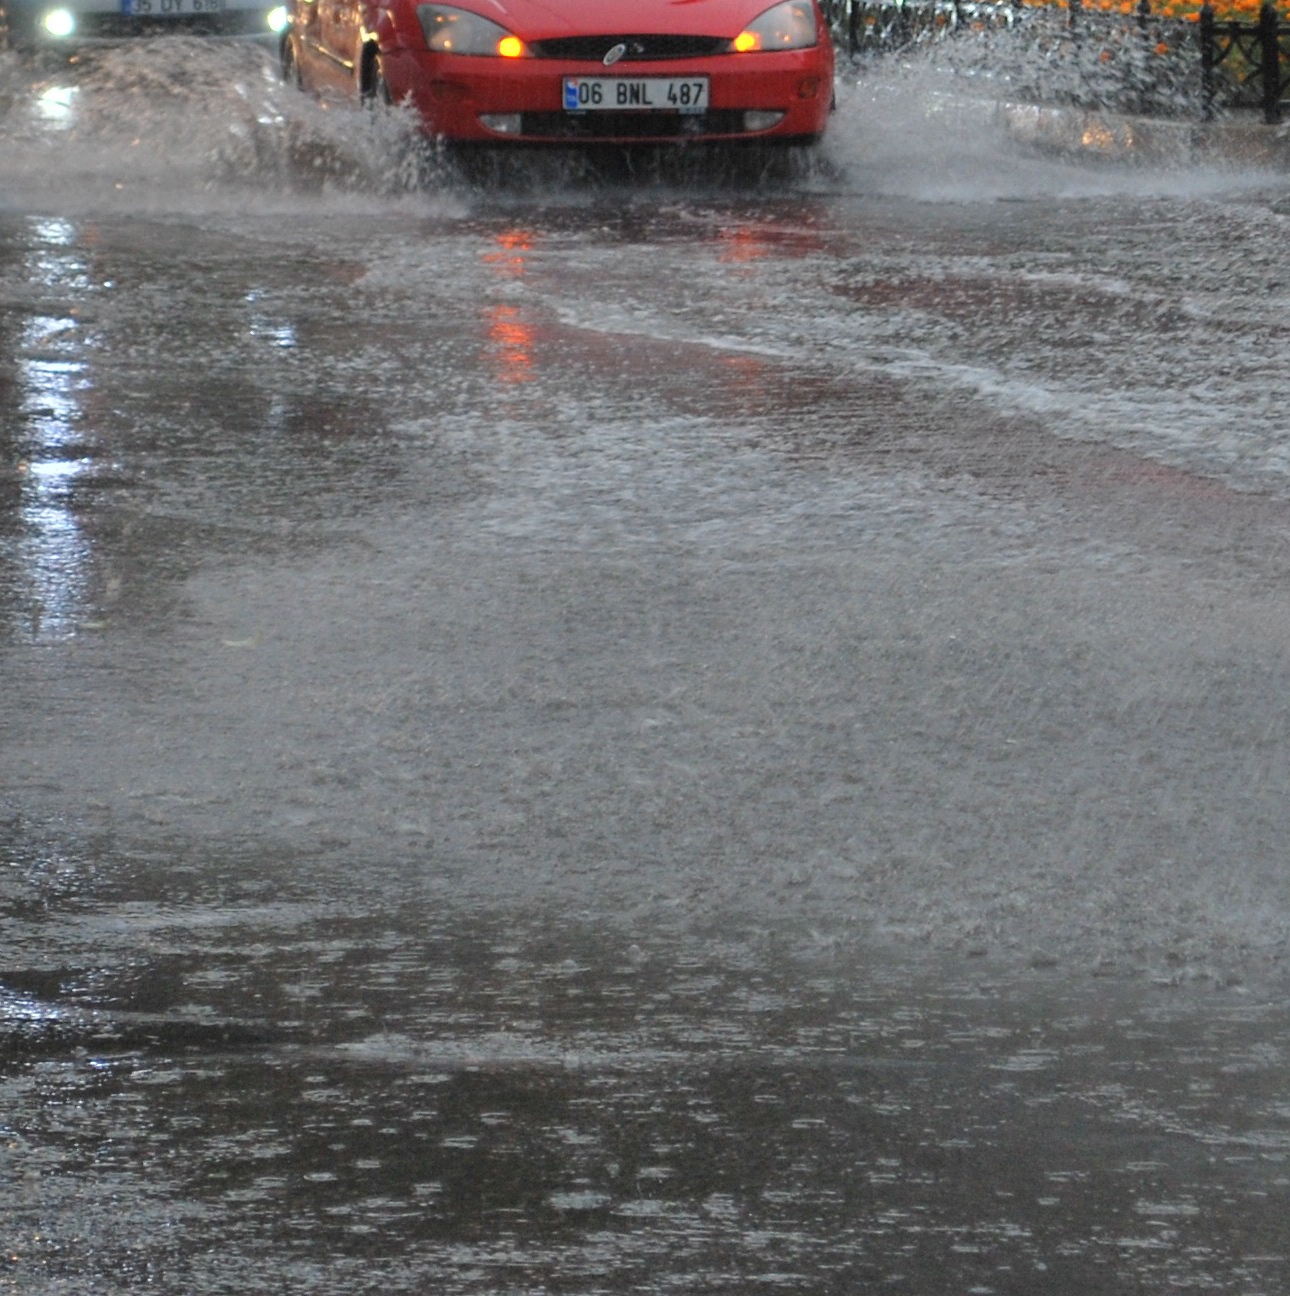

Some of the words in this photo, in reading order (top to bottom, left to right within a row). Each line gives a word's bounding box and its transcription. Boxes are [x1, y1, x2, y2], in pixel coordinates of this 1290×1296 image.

[578, 83, 603, 105] 06
[616, 83, 653, 105] BNL
[667, 83, 703, 105] 487
